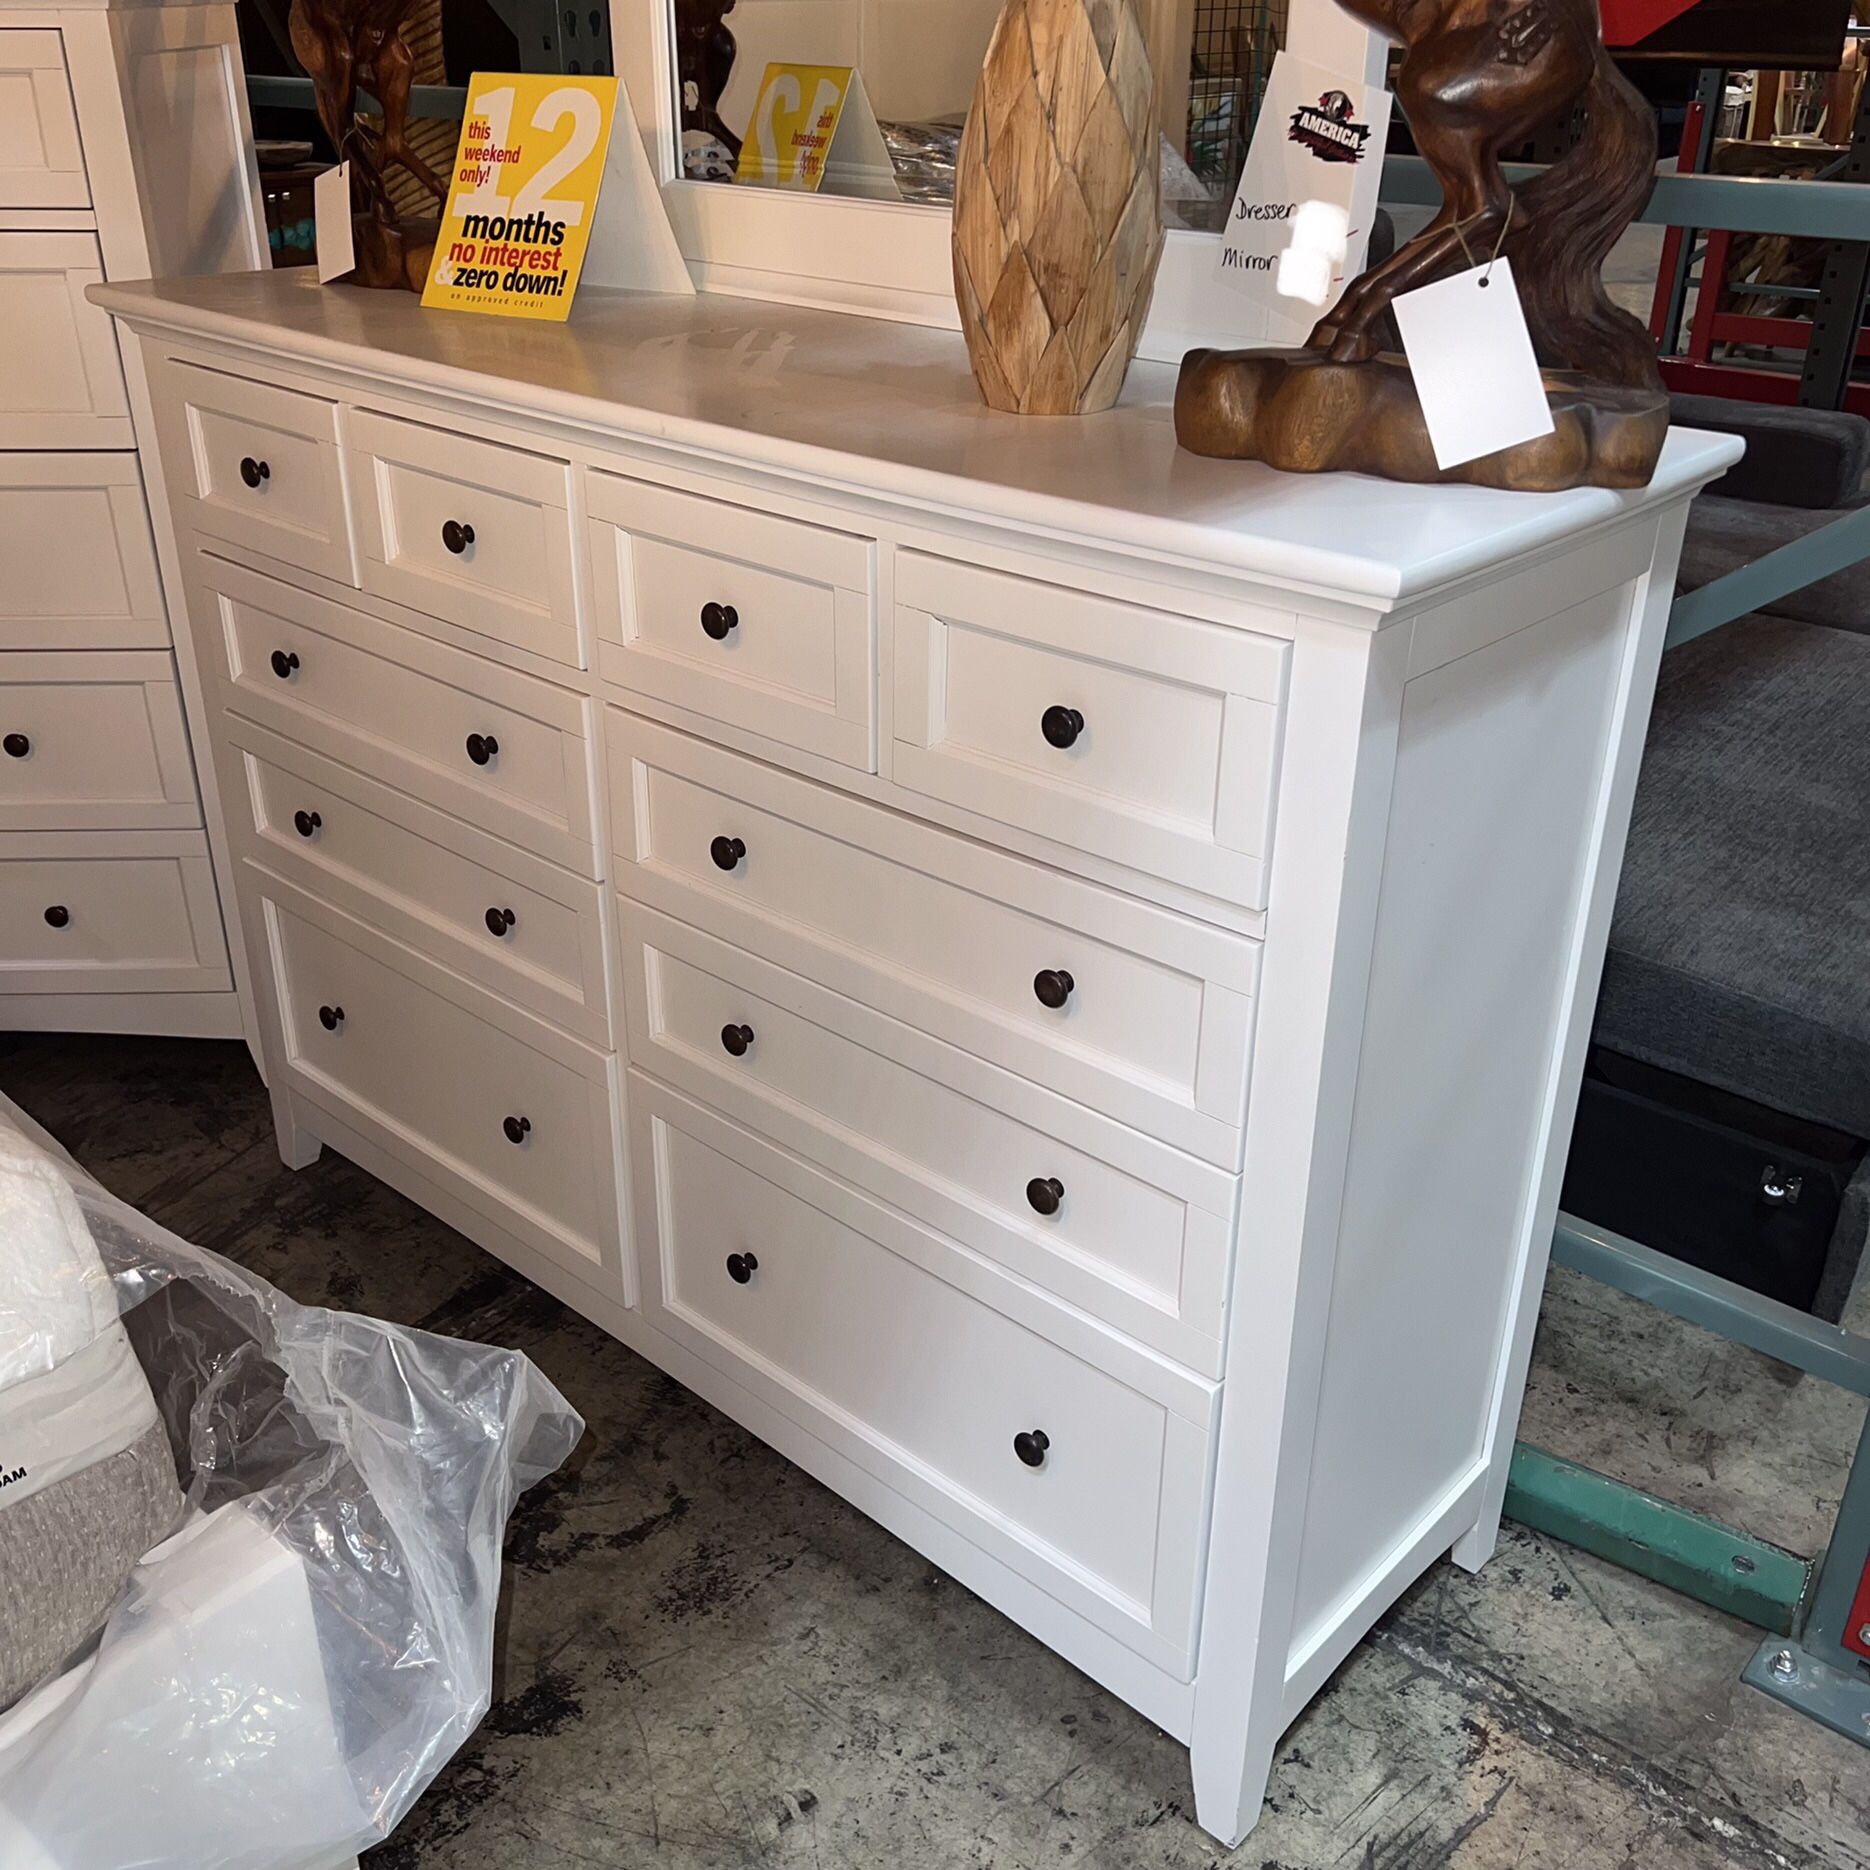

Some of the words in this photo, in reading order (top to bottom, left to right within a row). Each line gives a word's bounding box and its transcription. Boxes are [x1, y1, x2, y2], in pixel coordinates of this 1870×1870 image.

[468, 121, 491, 140] this
[1298, 111, 1360, 149] AMERICA
[452, 87, 601, 225] 12
[464, 145, 521, 164] weekend
[459, 165, 491, 187] only!
[1235, 197, 1297, 220] Dresser
[461, 211, 566, 246] months
[449, 241, 476, 263] no
[480, 239, 562, 271] interest
[1221, 248, 1278, 271] Mirror
[502, 265, 568, 297] down!
[514, 300, 544, 308] credit
